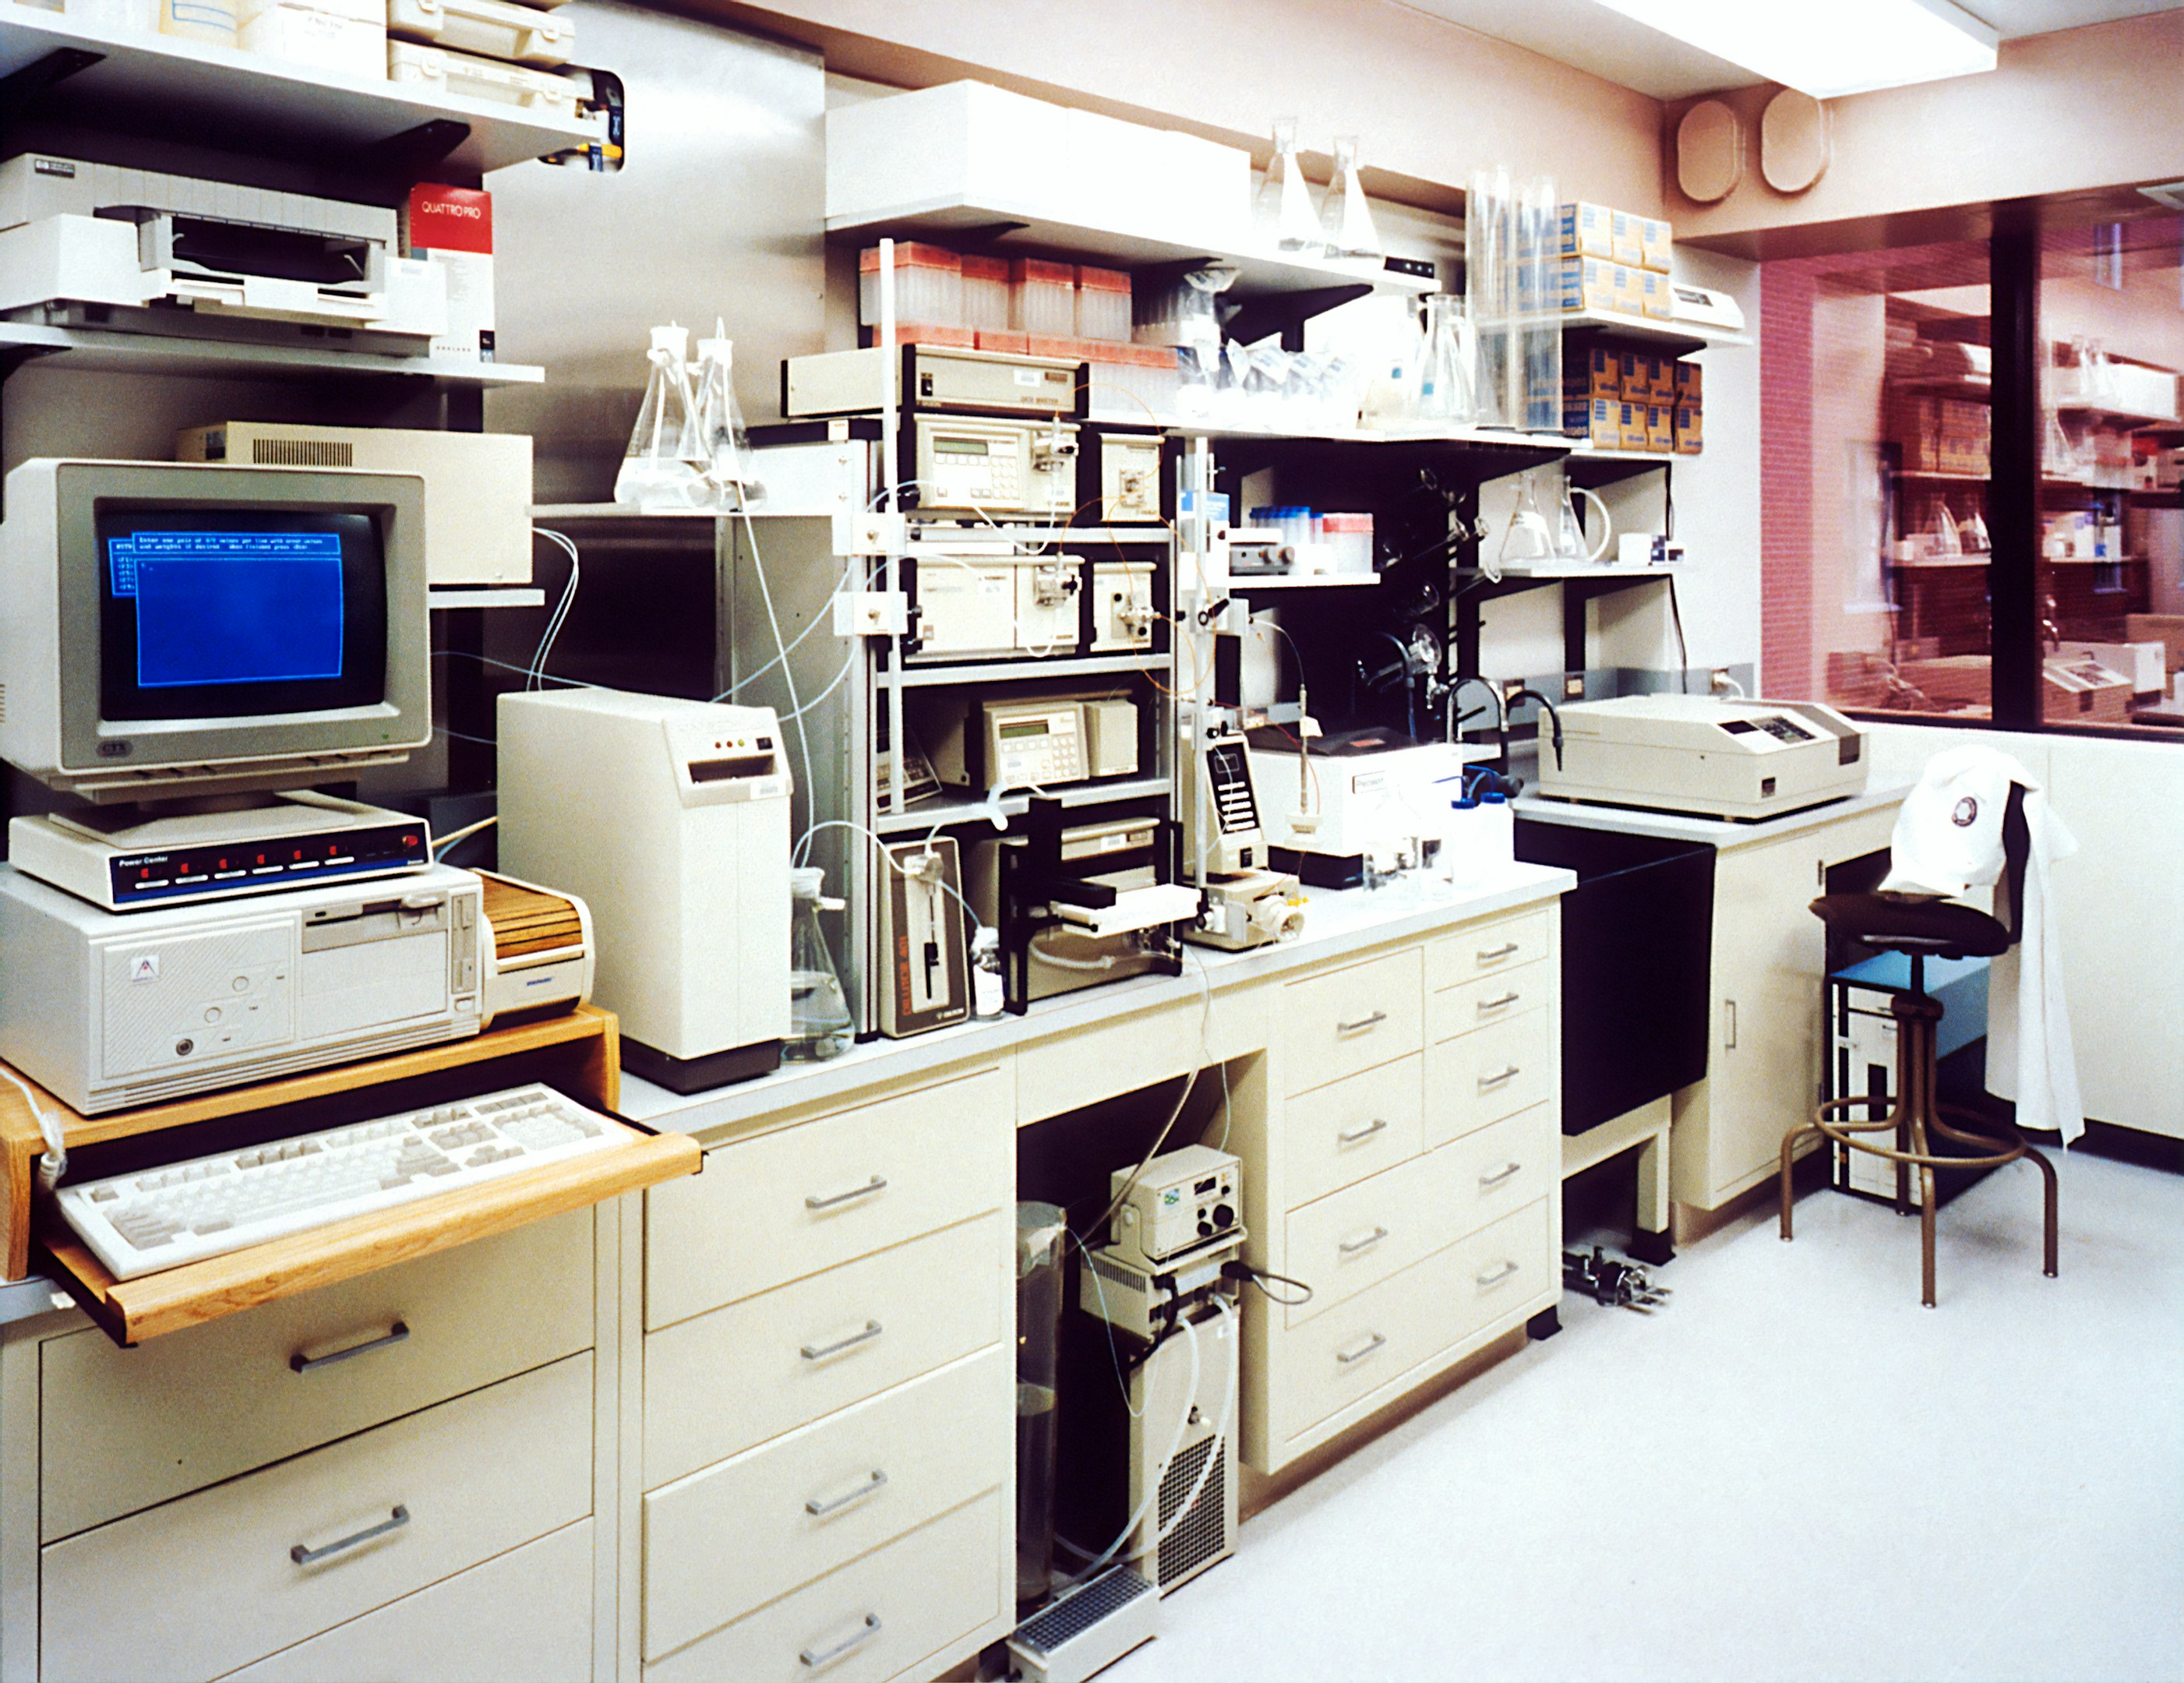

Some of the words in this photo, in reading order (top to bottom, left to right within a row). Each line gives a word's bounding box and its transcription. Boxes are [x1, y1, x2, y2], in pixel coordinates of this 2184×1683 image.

[422, 201, 463, 217] QUATTRO
[464, 206, 482, 220] PRO
[118, 859, 142, 867] Power
